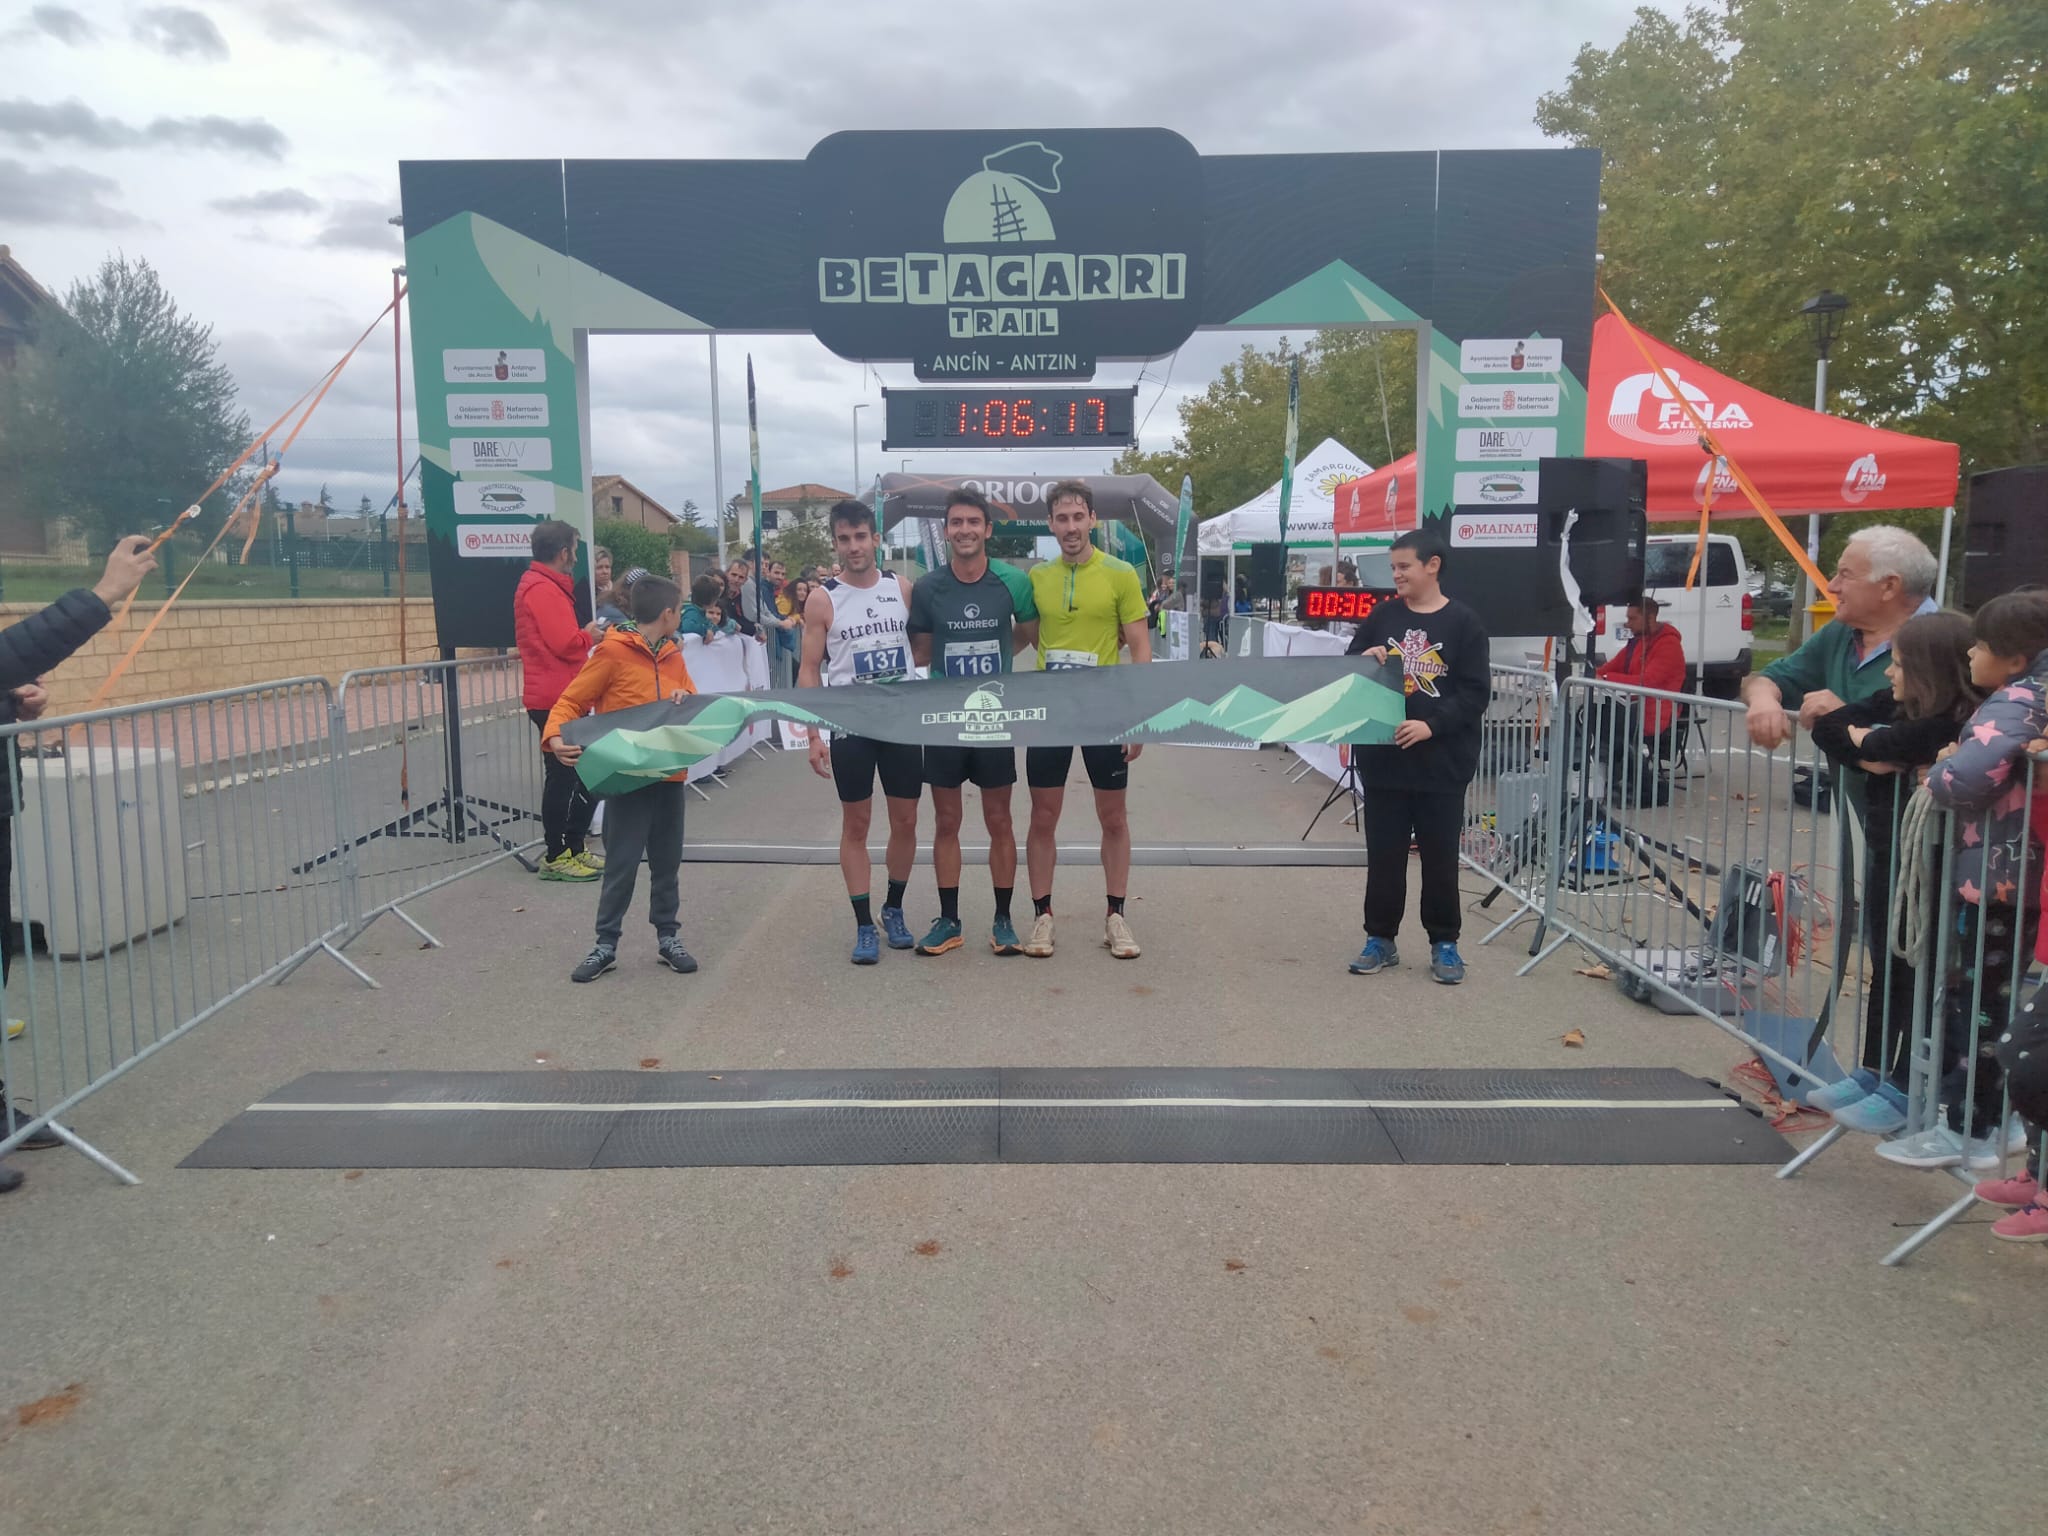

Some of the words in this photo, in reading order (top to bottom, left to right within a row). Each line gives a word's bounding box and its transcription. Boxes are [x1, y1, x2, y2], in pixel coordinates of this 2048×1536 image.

[821, 255, 1184, 302] BETAGARRI
[950, 309, 1058, 336] TRAIL
[933, 351, 990, 371] ANCÍN
[1010, 354, 1077, 371] ANTZIN
[958, 399, 1105, 437] 1:06:17
[1659, 402, 1750, 422] FNA
[478, 483, 524, 494] CONSTRUCCIONES
[480, 501, 525, 512] INSTALACIONES
[947, 619, 999, 630] TXURREGI
[863, 649, 899, 672] 137
[955, 656, 993, 675] 116
